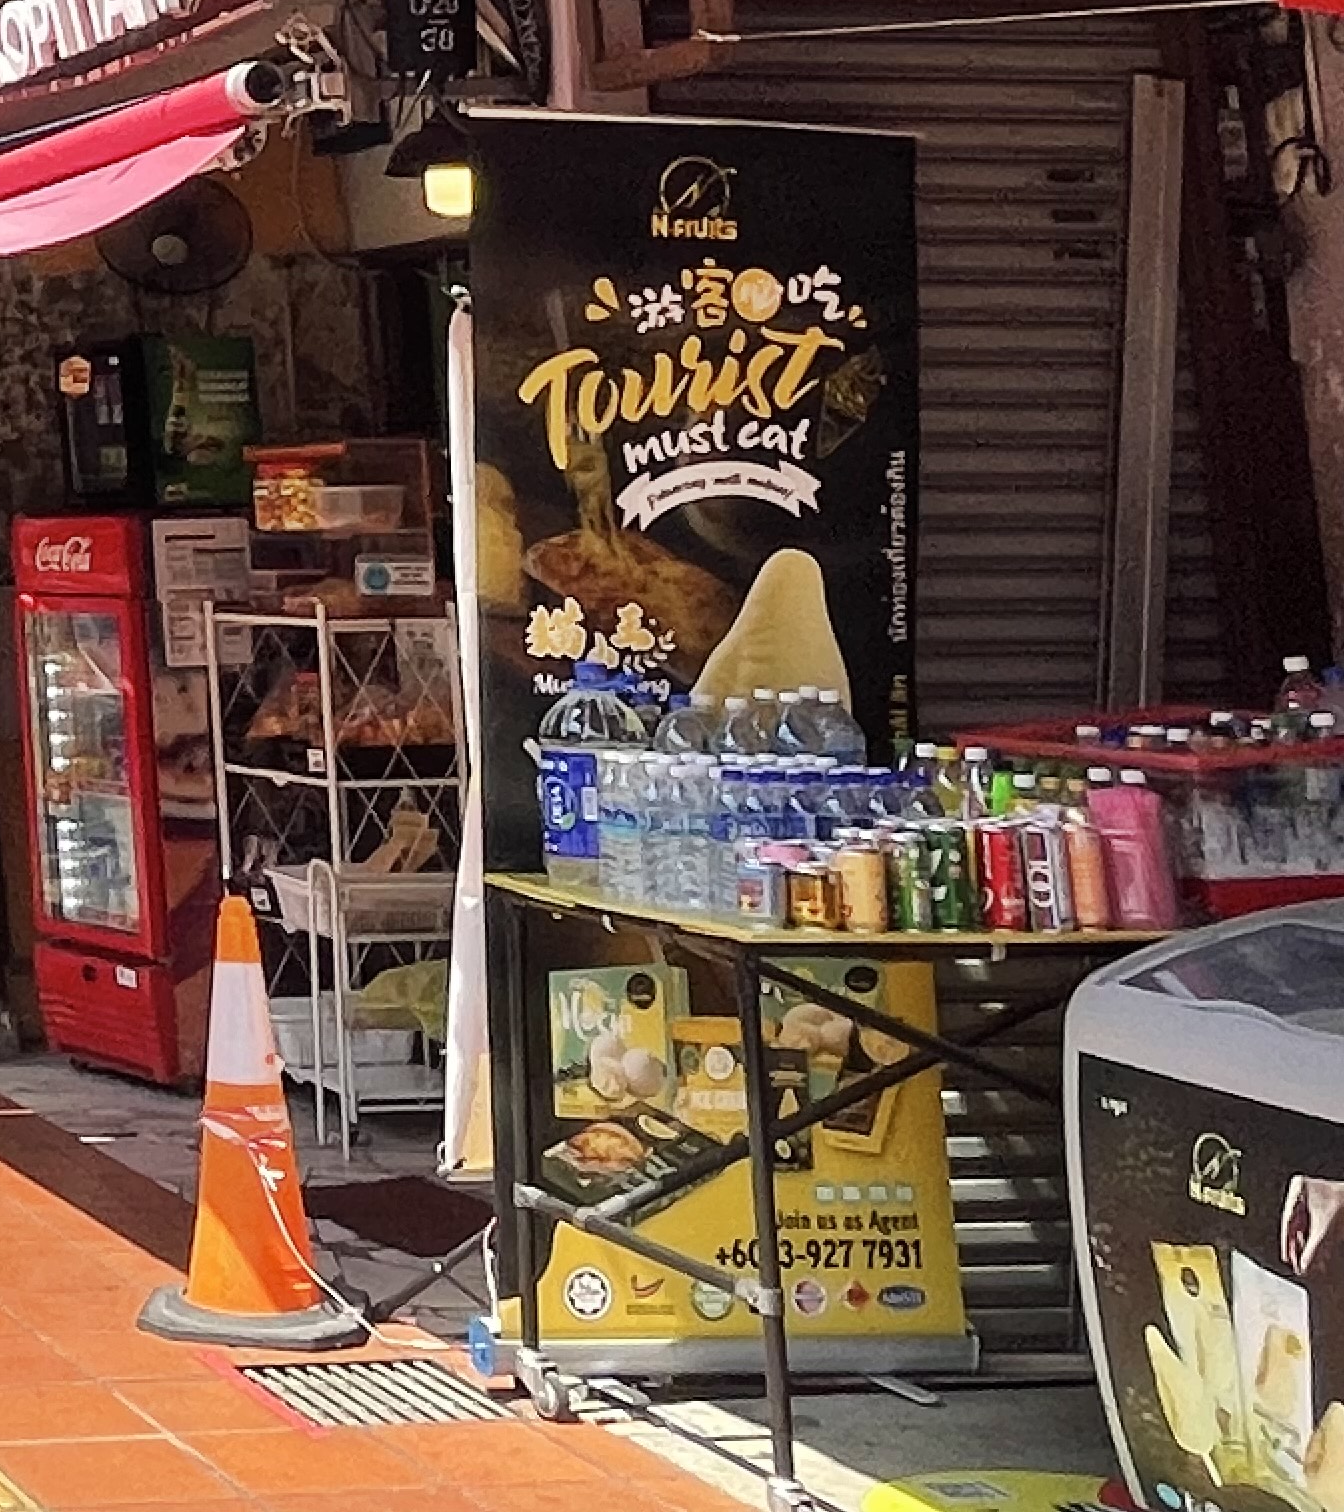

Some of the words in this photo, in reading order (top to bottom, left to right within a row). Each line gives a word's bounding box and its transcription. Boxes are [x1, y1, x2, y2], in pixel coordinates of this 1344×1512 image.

[517, 325, 847, 470] Tourist
[622, 409, 731, 474] must
[816, 1214, 838, 1231] us
[842, 1214, 863, 1231] as
[868, 1209, 920, 1236] Agent
[715, 1238, 854, 1270] +603-927
[862, 1238, 923, 1270] 7931
